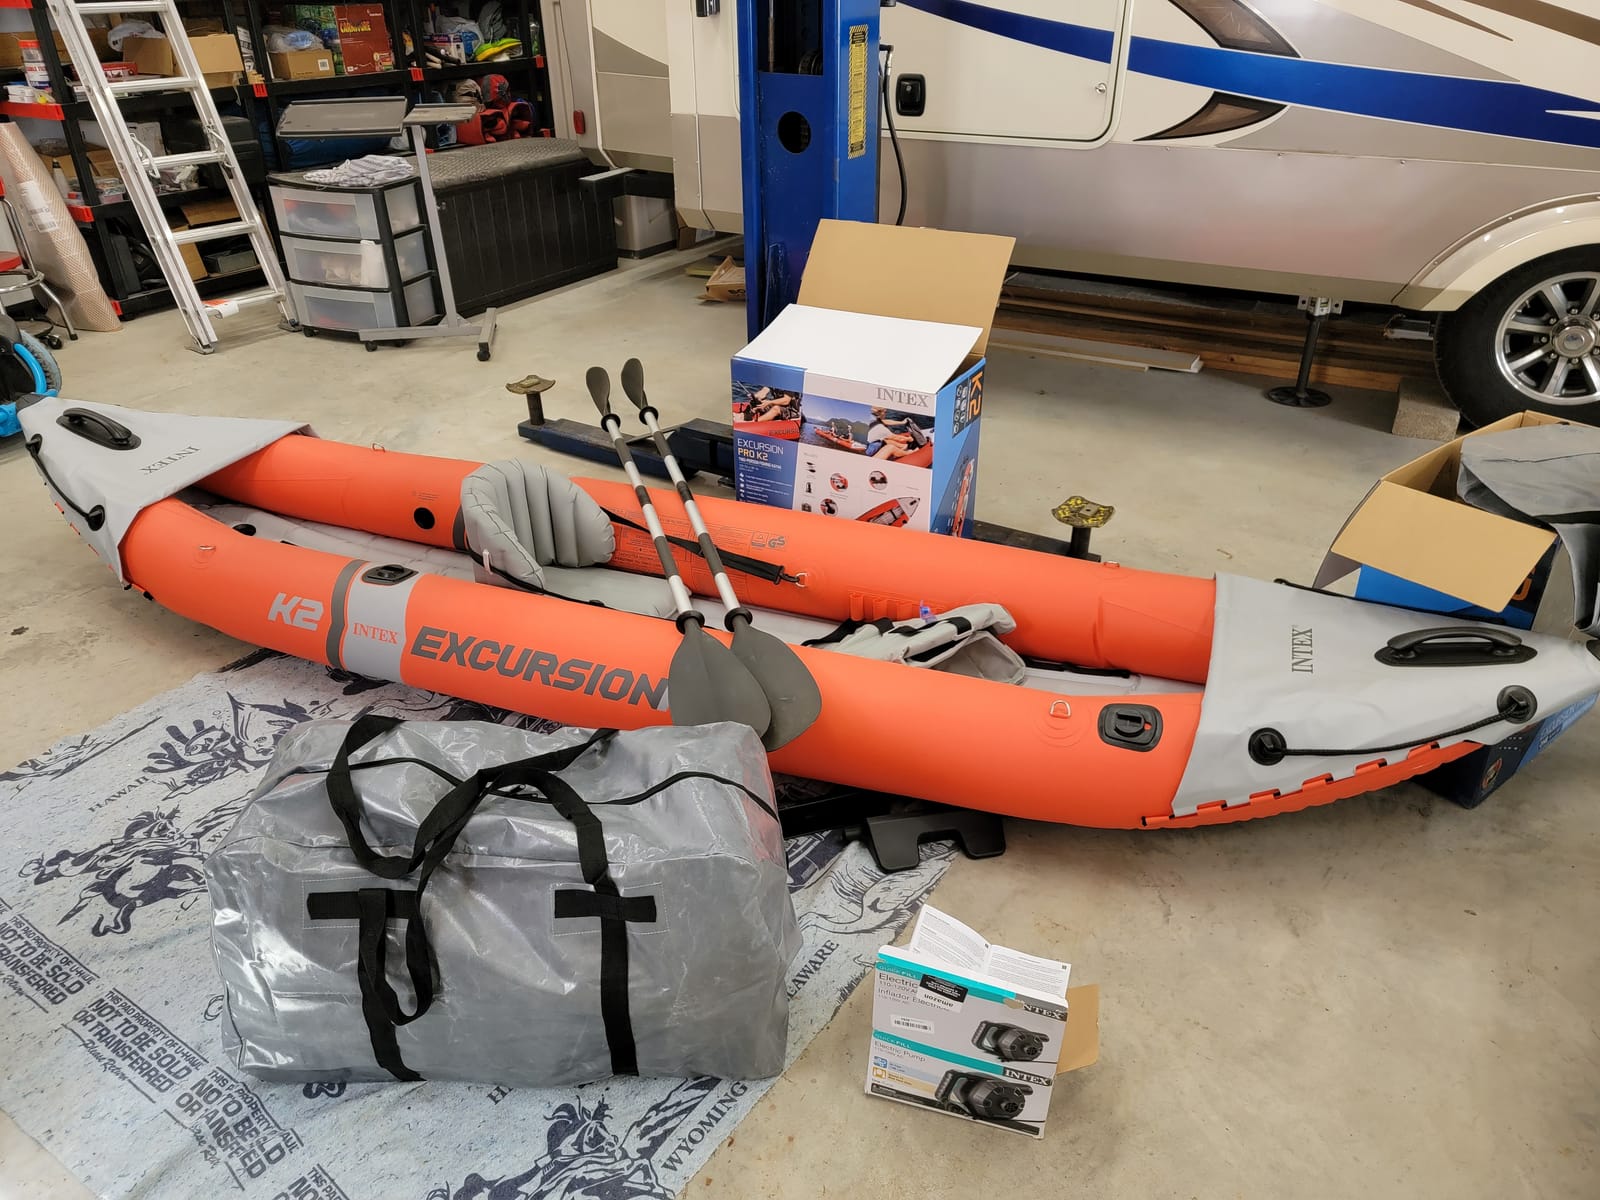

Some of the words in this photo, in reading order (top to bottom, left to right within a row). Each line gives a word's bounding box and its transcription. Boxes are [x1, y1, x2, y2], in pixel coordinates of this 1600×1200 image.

[877, 387, 929, 408] INTEX
[737, 438, 784, 455] EXCURSION
[738, 448, 755, 458] PRO
[756, 451, 768, 461] K2
[140, 446, 200, 473] INTEX
[267, 592, 324, 631] K2
[353, 622, 398, 645] INTEX
[1292, 627, 1313, 674] INTEX
[410, 626, 668, 710] EXCURSION
[15, 940, 37, 958] TO
[29, 951, 53, 971] BE
[46, 964, 85, 995] SOLD
[879, 972, 919, 989] Electric
[878, 987, 910, 1001] Inflador
[924, 993, 954, 1008] amazon
[105, 990, 123, 1005] THIS
[119, 1001, 136, 1016] PAD
[131, 1011, 170, 1041] PROPERTY
[164, 1038, 178, 1050] OF
[1023, 1003, 1061, 1020] NTEX
[72, 1009, 97, 1027] OR
[87, 1020, 175, 1093] TRANSFERRED
[87, 998, 123, 1023] NOT
[114, 1017, 139, 1038] TO
[130, 1030, 158, 1053] BE
[147, 1046, 192, 1080] SOLD
[874, 1040, 901, 1056] Electric
[903, 1050, 926, 1062] Pump
[1005, 1069, 1049, 1086] INTEX
[175, 1092, 204, 1117] OR
[208, 1069, 230, 1088] THIS
[234, 1087, 275, 1132] PROPERTY
[661, 1081, 748, 1172] WYOMING
[306, 1166, 327, 1188] THIS
